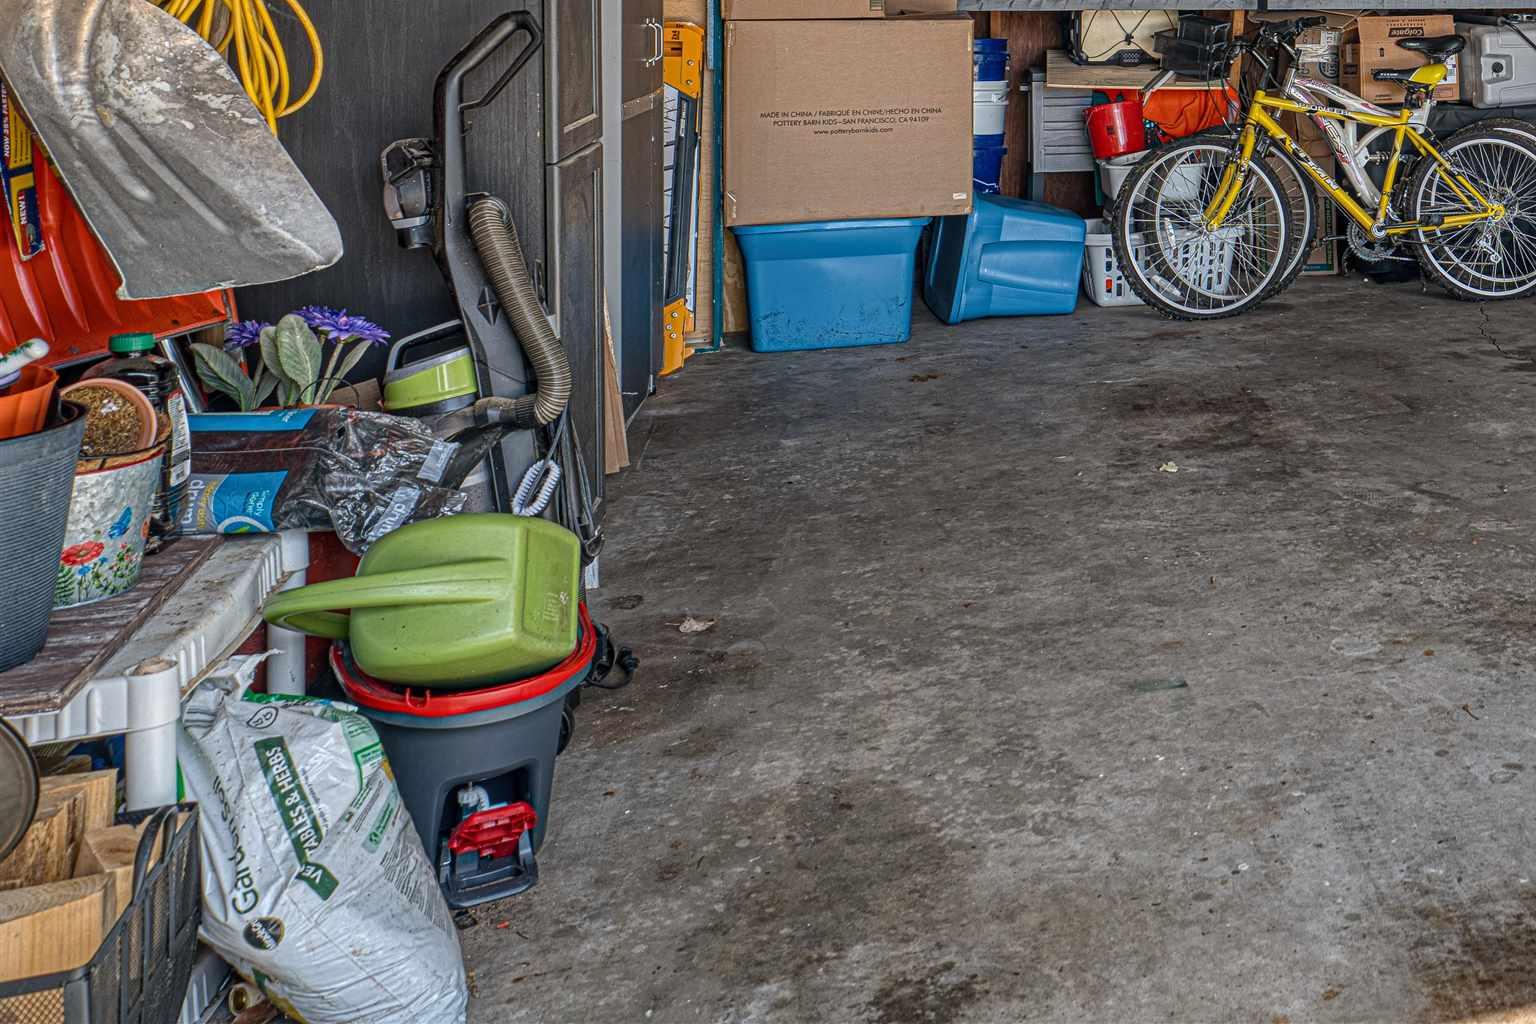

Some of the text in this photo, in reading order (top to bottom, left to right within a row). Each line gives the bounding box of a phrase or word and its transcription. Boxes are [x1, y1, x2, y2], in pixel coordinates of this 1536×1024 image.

[1390, 28, 1423, 36] Colgate
[773, 119, 801, 127] POTTERY
[18, 195, 27, 224] NEW!
[266, 745, 293, 793] HERBS
